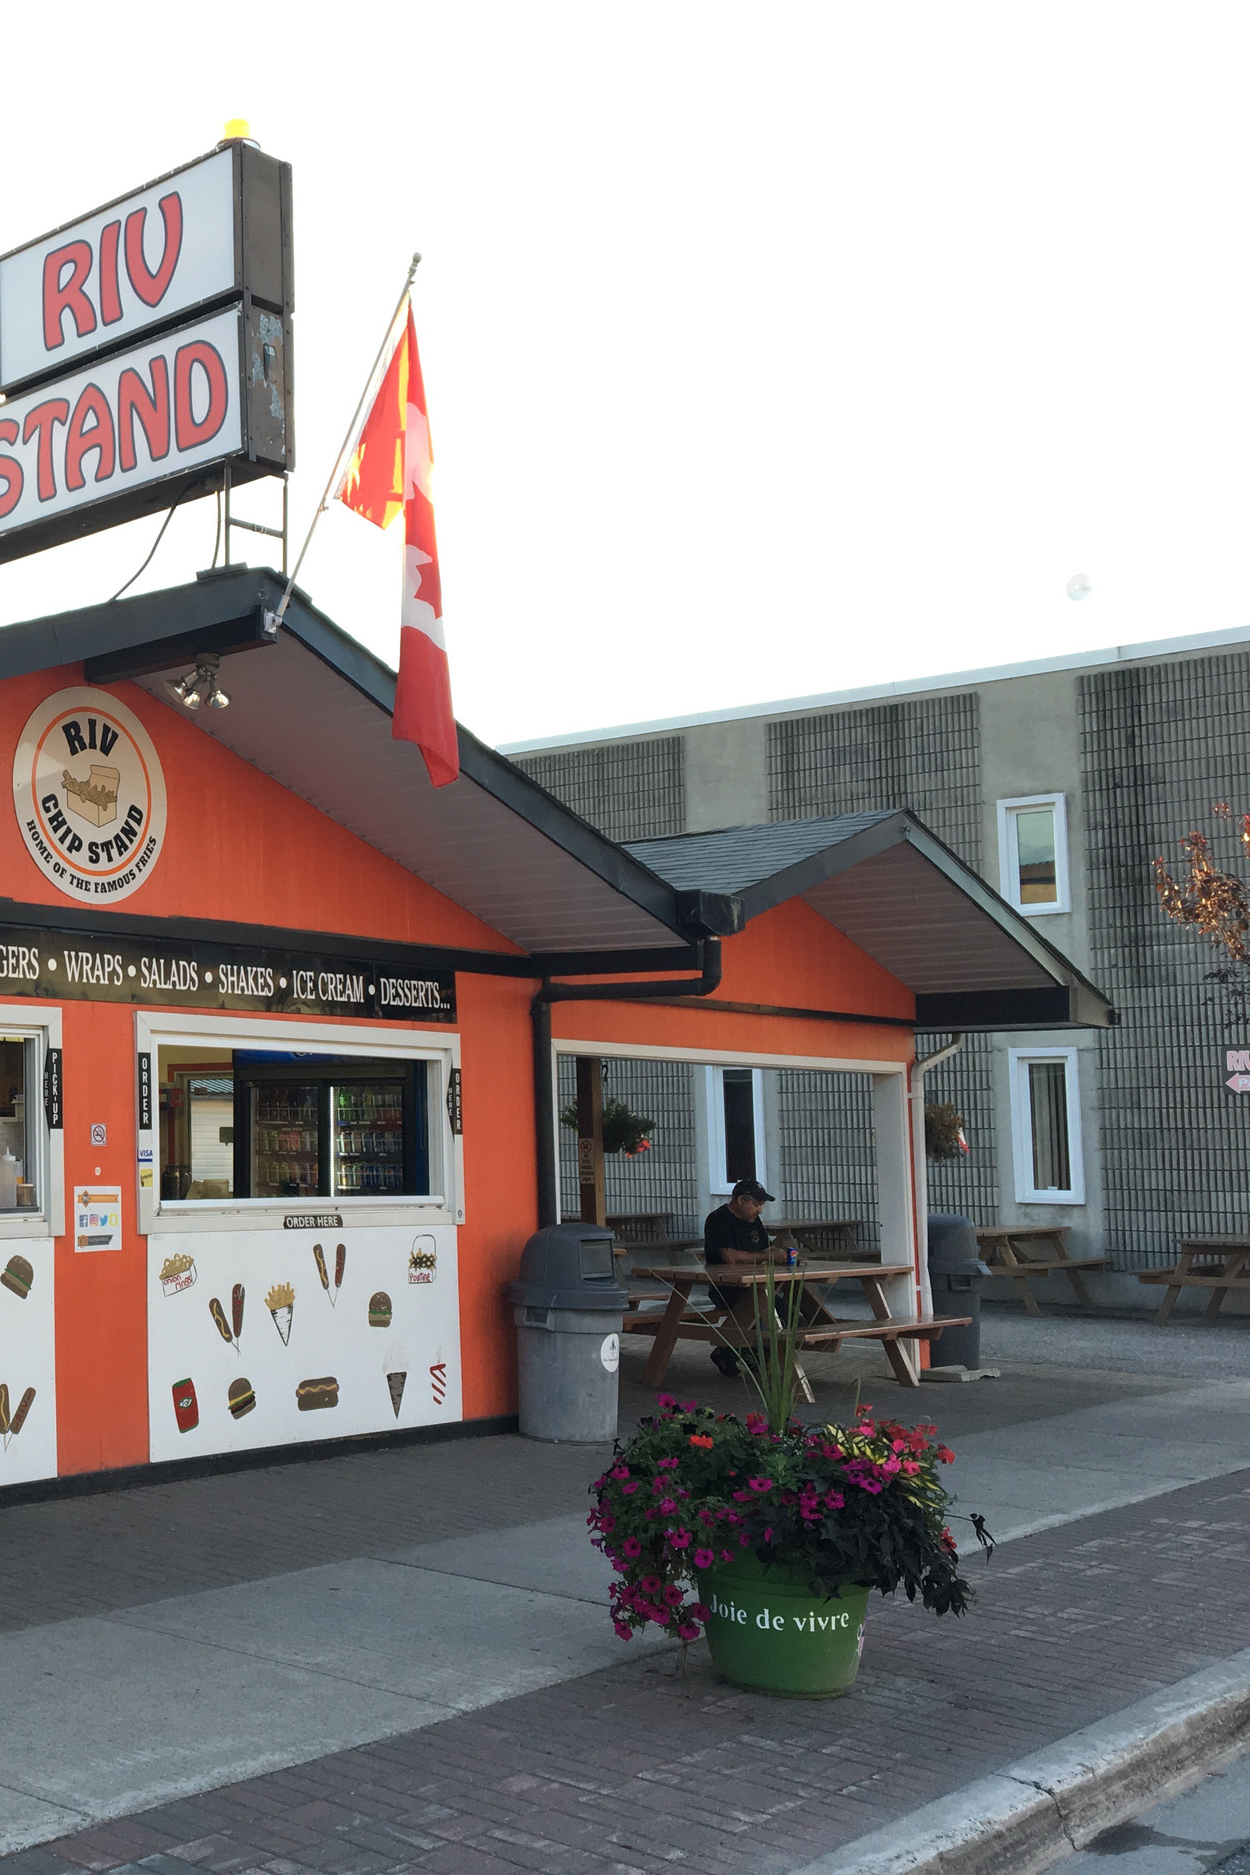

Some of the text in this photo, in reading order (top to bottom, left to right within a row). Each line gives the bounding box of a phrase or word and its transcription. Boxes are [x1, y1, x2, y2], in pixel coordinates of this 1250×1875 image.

[42, 191, 183, 351] RIV
[62, 718, 119, 756] RIV
[41, 793, 144, 864] CHIP STAND
[27, 819, 157, 893] HOME OF THE FAMOUS FRIES
[63, 950, 123, 986] WRAPS
[141, 957, 198, 991] SALADS
[218, 964, 274, 997] SHAKES
[293, 970, 315, 999] ICE
[318, 972, 364, 1002] CREAM
[141, 1057, 149, 1124] ORDER
[140, 1149, 153, 1157] VISA
[286, 1216, 338, 1228] ORDER HERE
[710, 1594, 849, 1632] Joie de vivre
